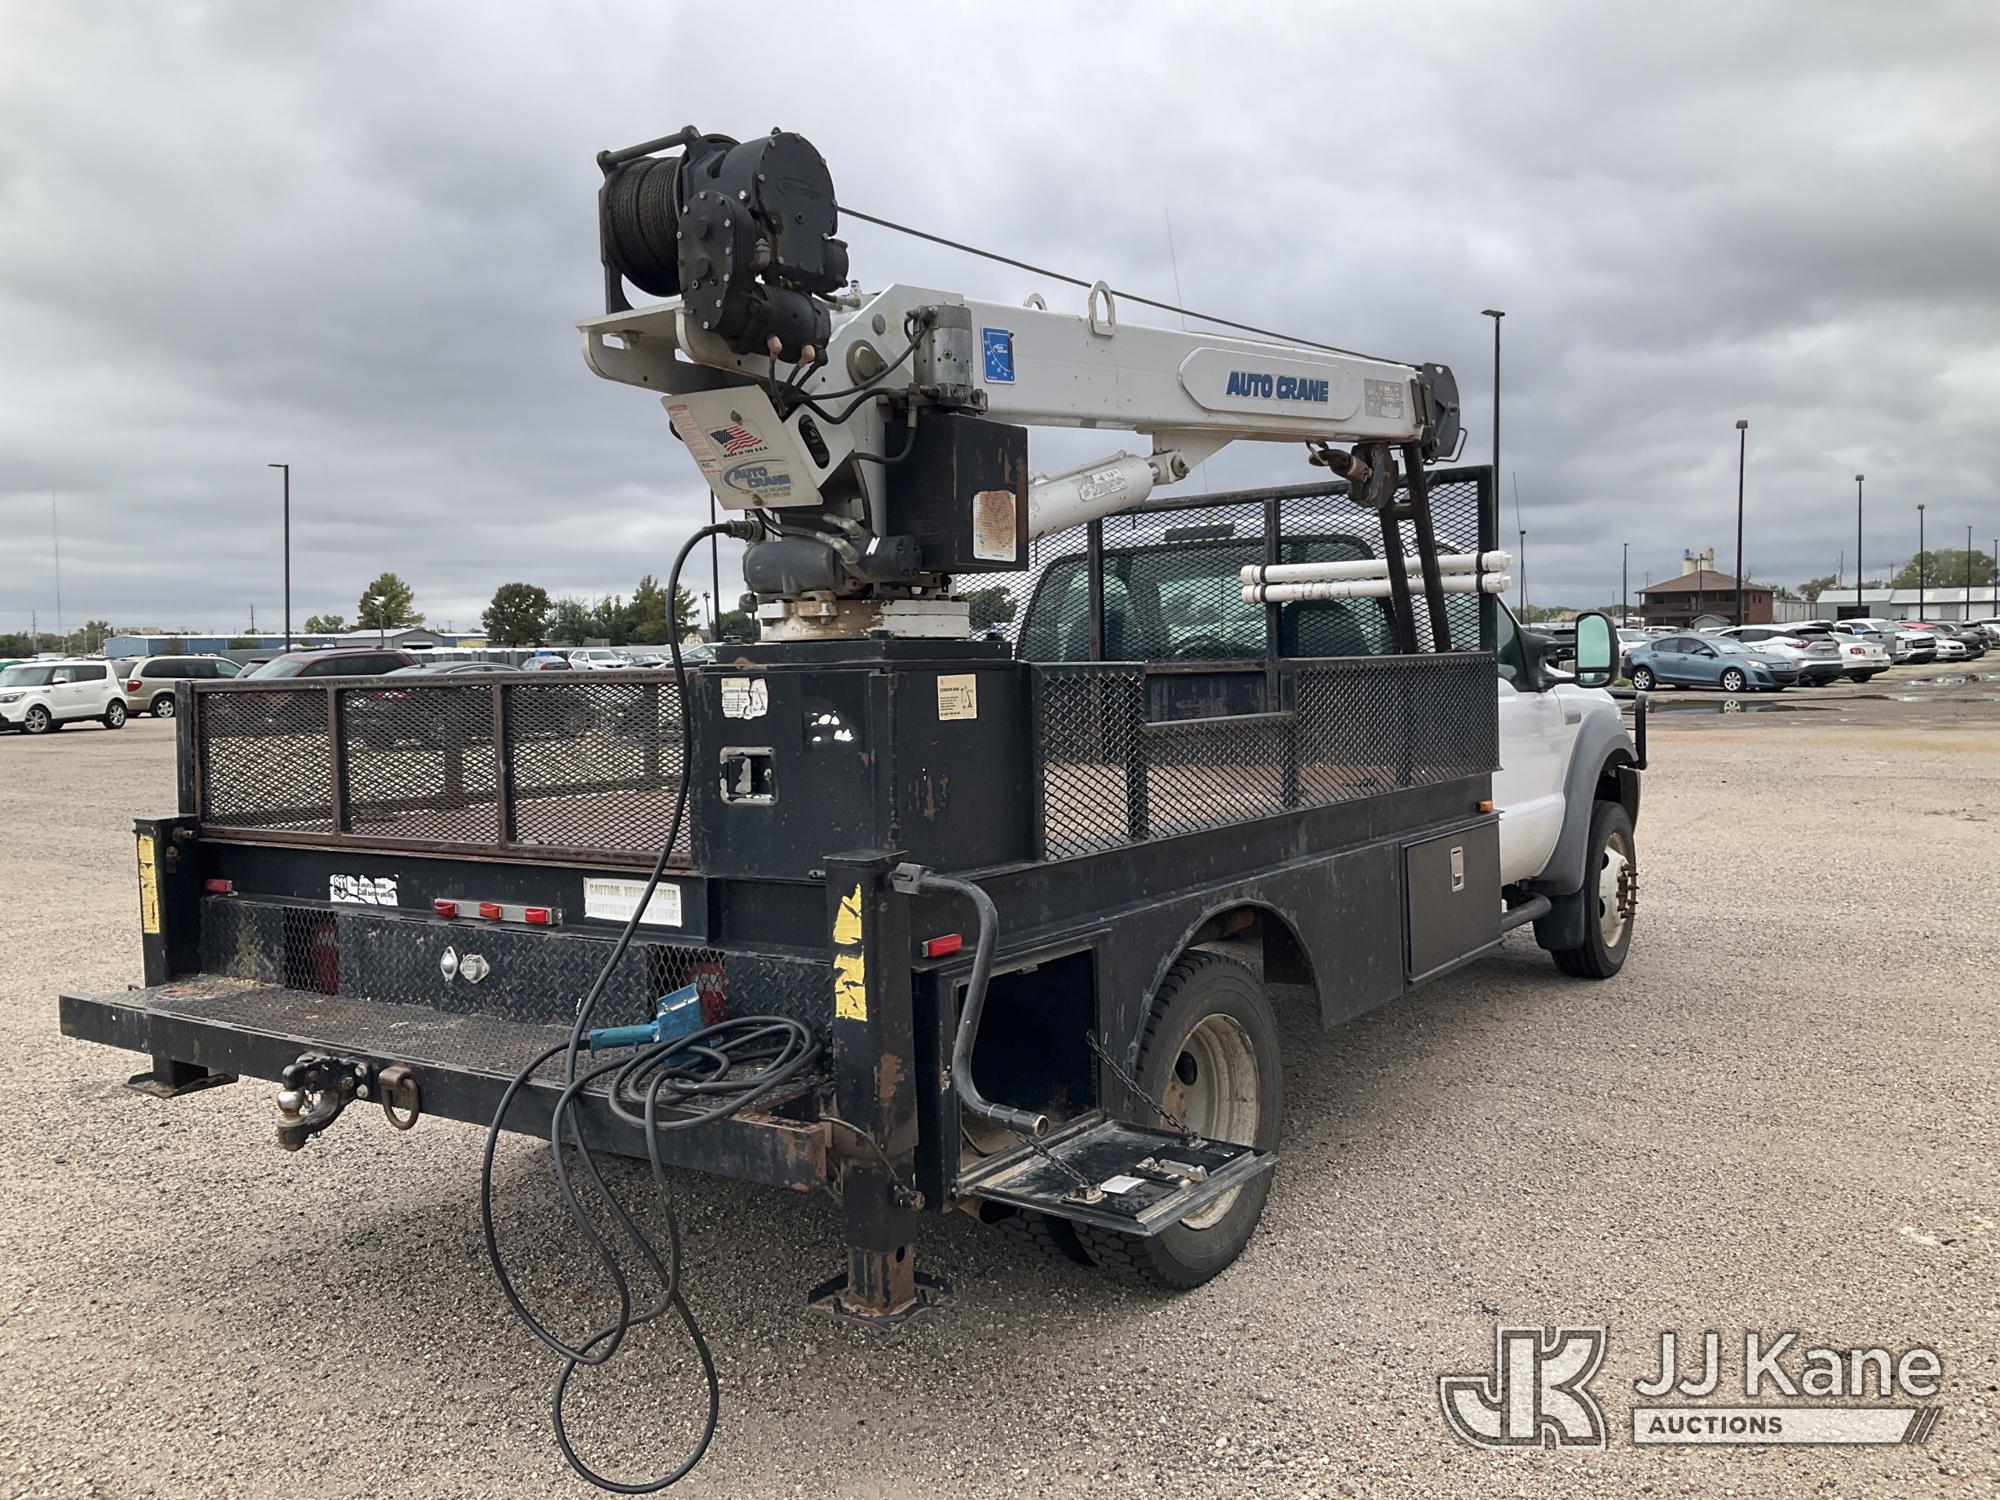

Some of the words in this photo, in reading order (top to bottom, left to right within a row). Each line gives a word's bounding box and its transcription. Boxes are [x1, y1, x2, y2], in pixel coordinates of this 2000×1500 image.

[1226, 371, 1273, 398] AUTO
[1276, 376, 1329, 402] CRANE
[734, 466, 768, 481] AUTO
[746, 474, 791, 488] CRANE
